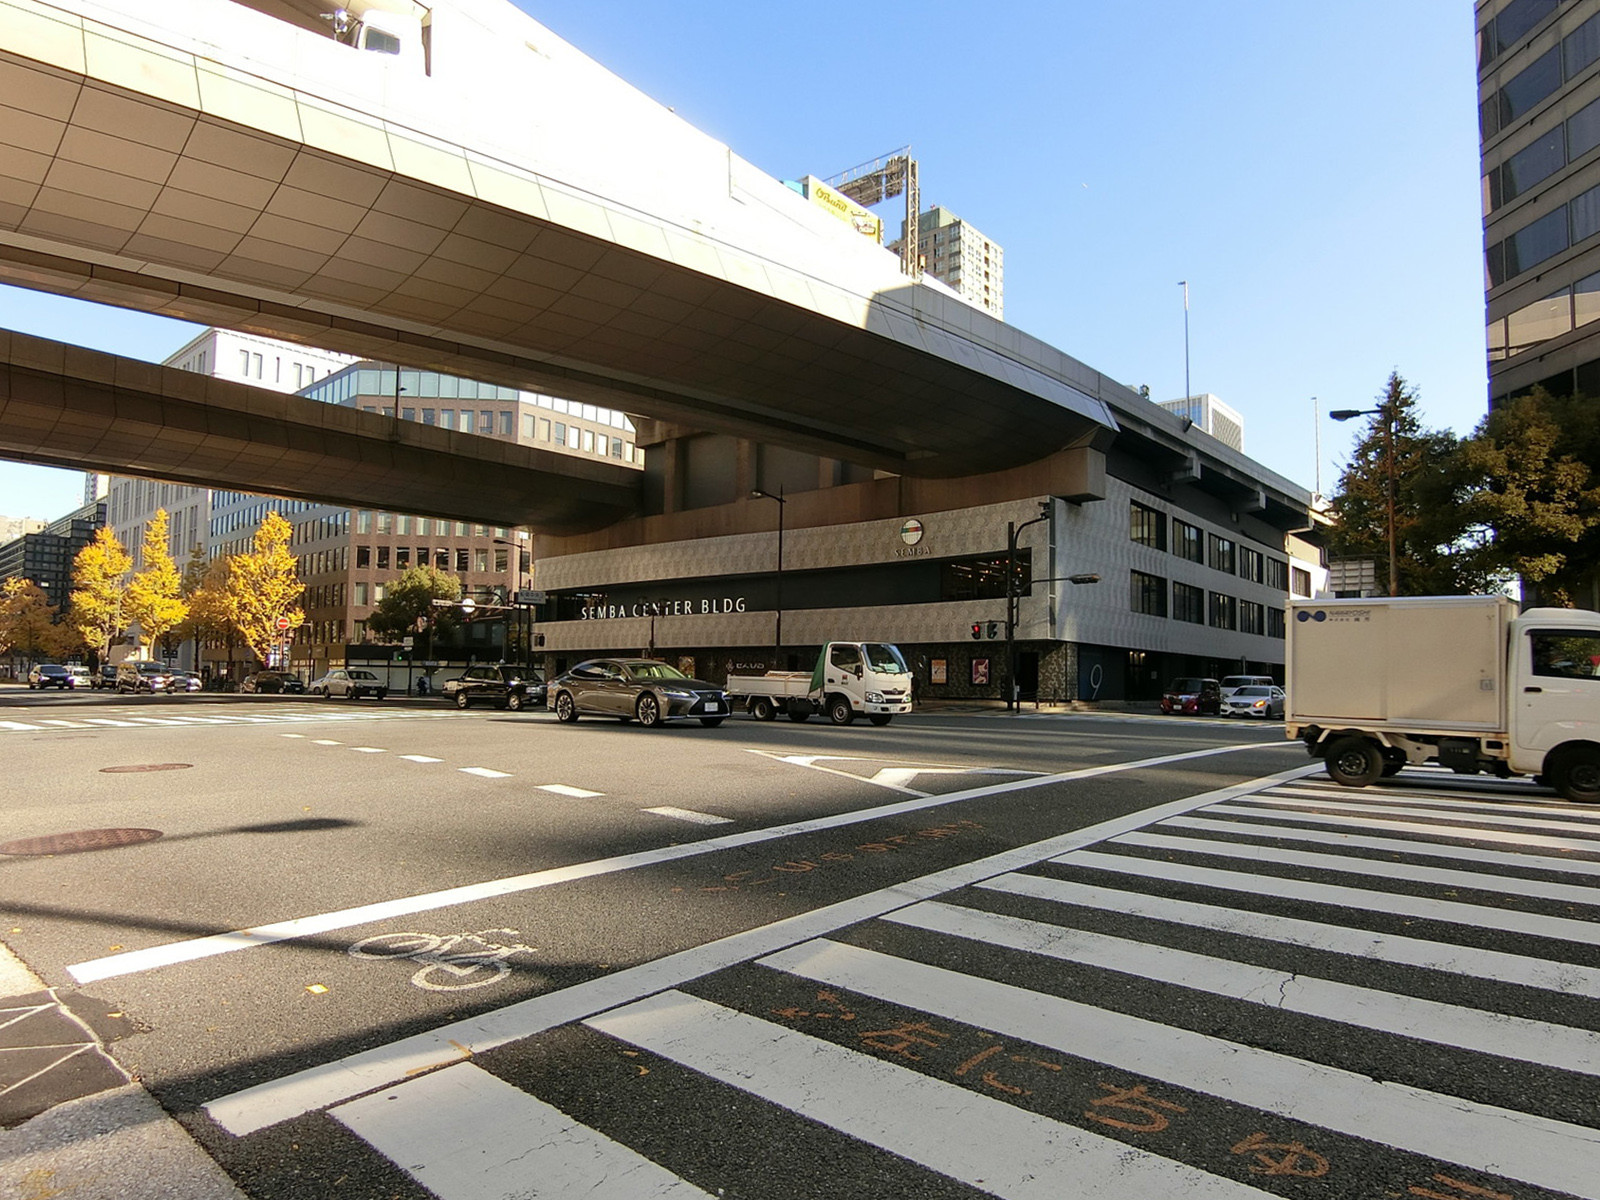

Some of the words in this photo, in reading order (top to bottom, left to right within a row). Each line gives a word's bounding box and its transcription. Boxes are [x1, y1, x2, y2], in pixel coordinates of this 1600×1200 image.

[894, 546, 932, 558] SEMBA
[581, 604, 627, 620] SEMBA
[632, 600, 693, 618] CENTER
[701, 597, 746, 614] BLDG
[1090, 663, 1103, 700] 9
